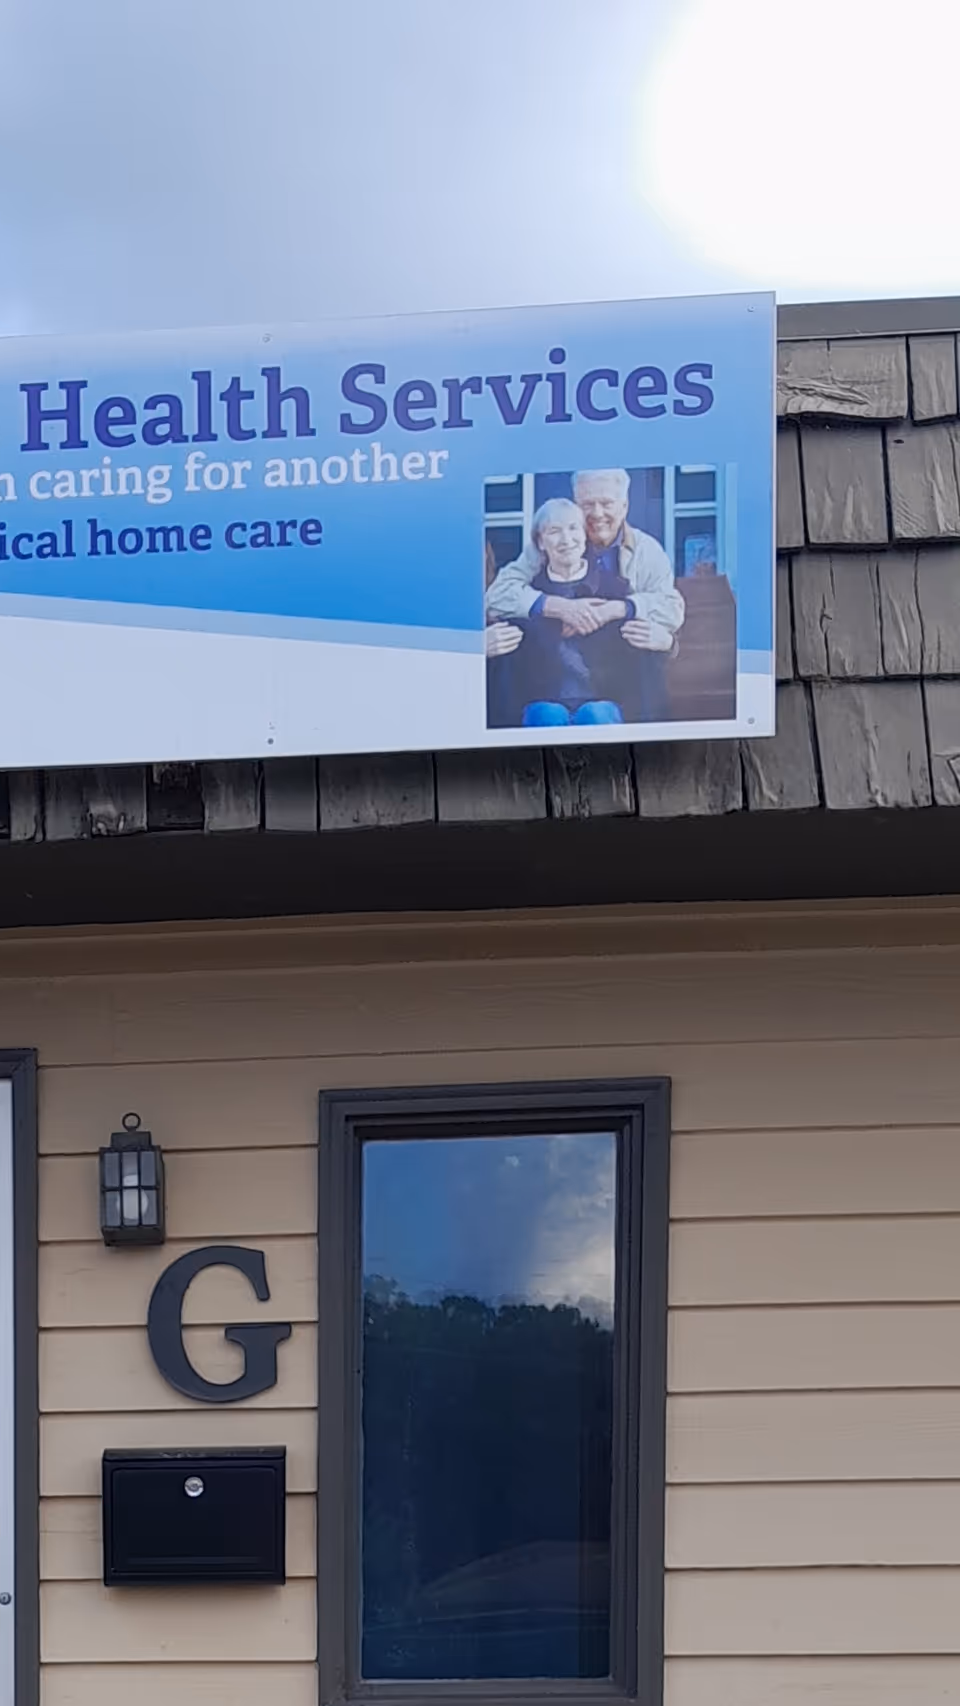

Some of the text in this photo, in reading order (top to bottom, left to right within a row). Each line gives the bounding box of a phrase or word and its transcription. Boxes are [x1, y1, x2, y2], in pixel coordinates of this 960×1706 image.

[19, 366, 316, 451] Health
[339, 347, 715, 436] Services
[29, 459, 172, 504] caring
[184, 450, 252, 492] for
[264, 442, 449, 488] another
[87, 518, 212, 556] home
[225, 517, 323, 551] care
[147, 1245, 292, 1403] G
